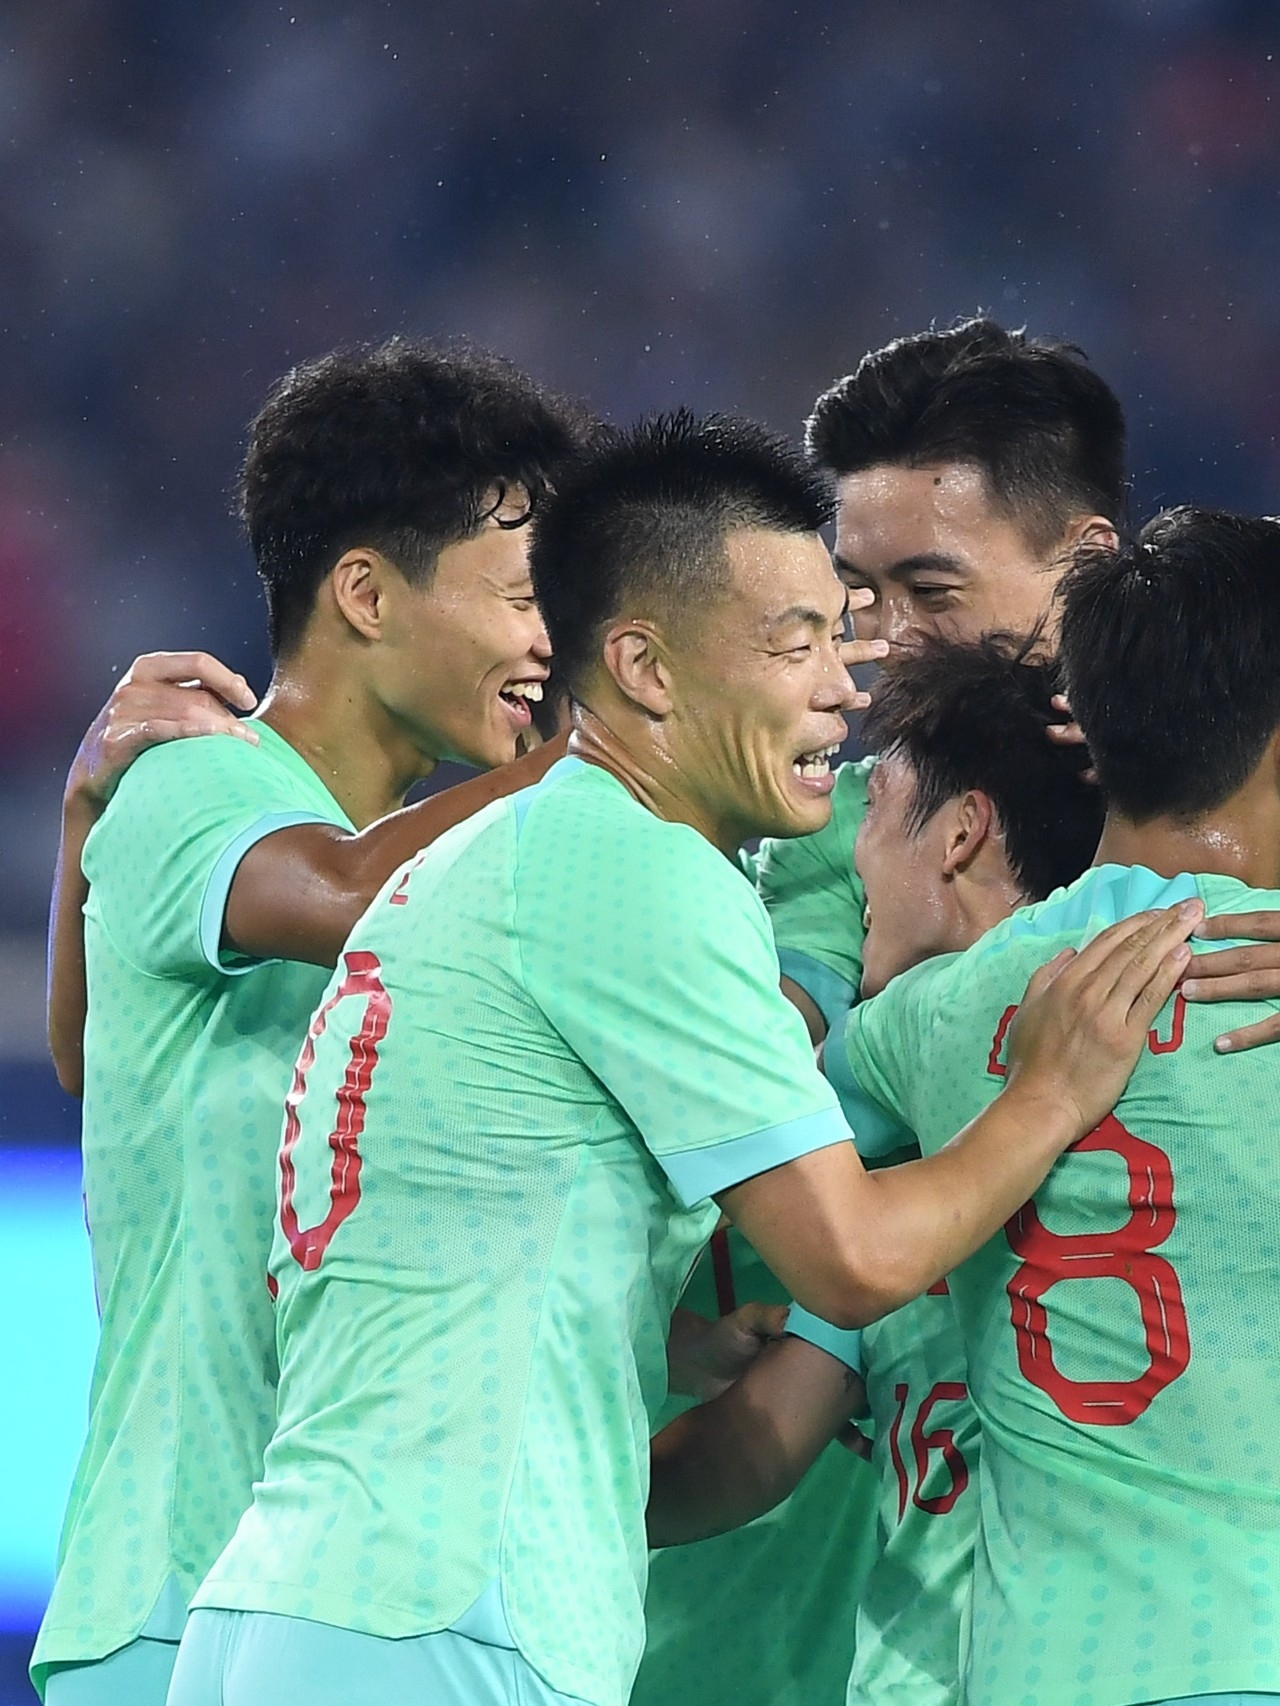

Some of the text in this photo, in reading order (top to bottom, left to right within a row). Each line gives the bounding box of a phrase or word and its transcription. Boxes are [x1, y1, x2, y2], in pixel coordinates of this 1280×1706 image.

[272, 951, 392, 1285] 0
[1004, 1113, 1191, 1426] 8
[890, 1381, 969, 1526] 16
